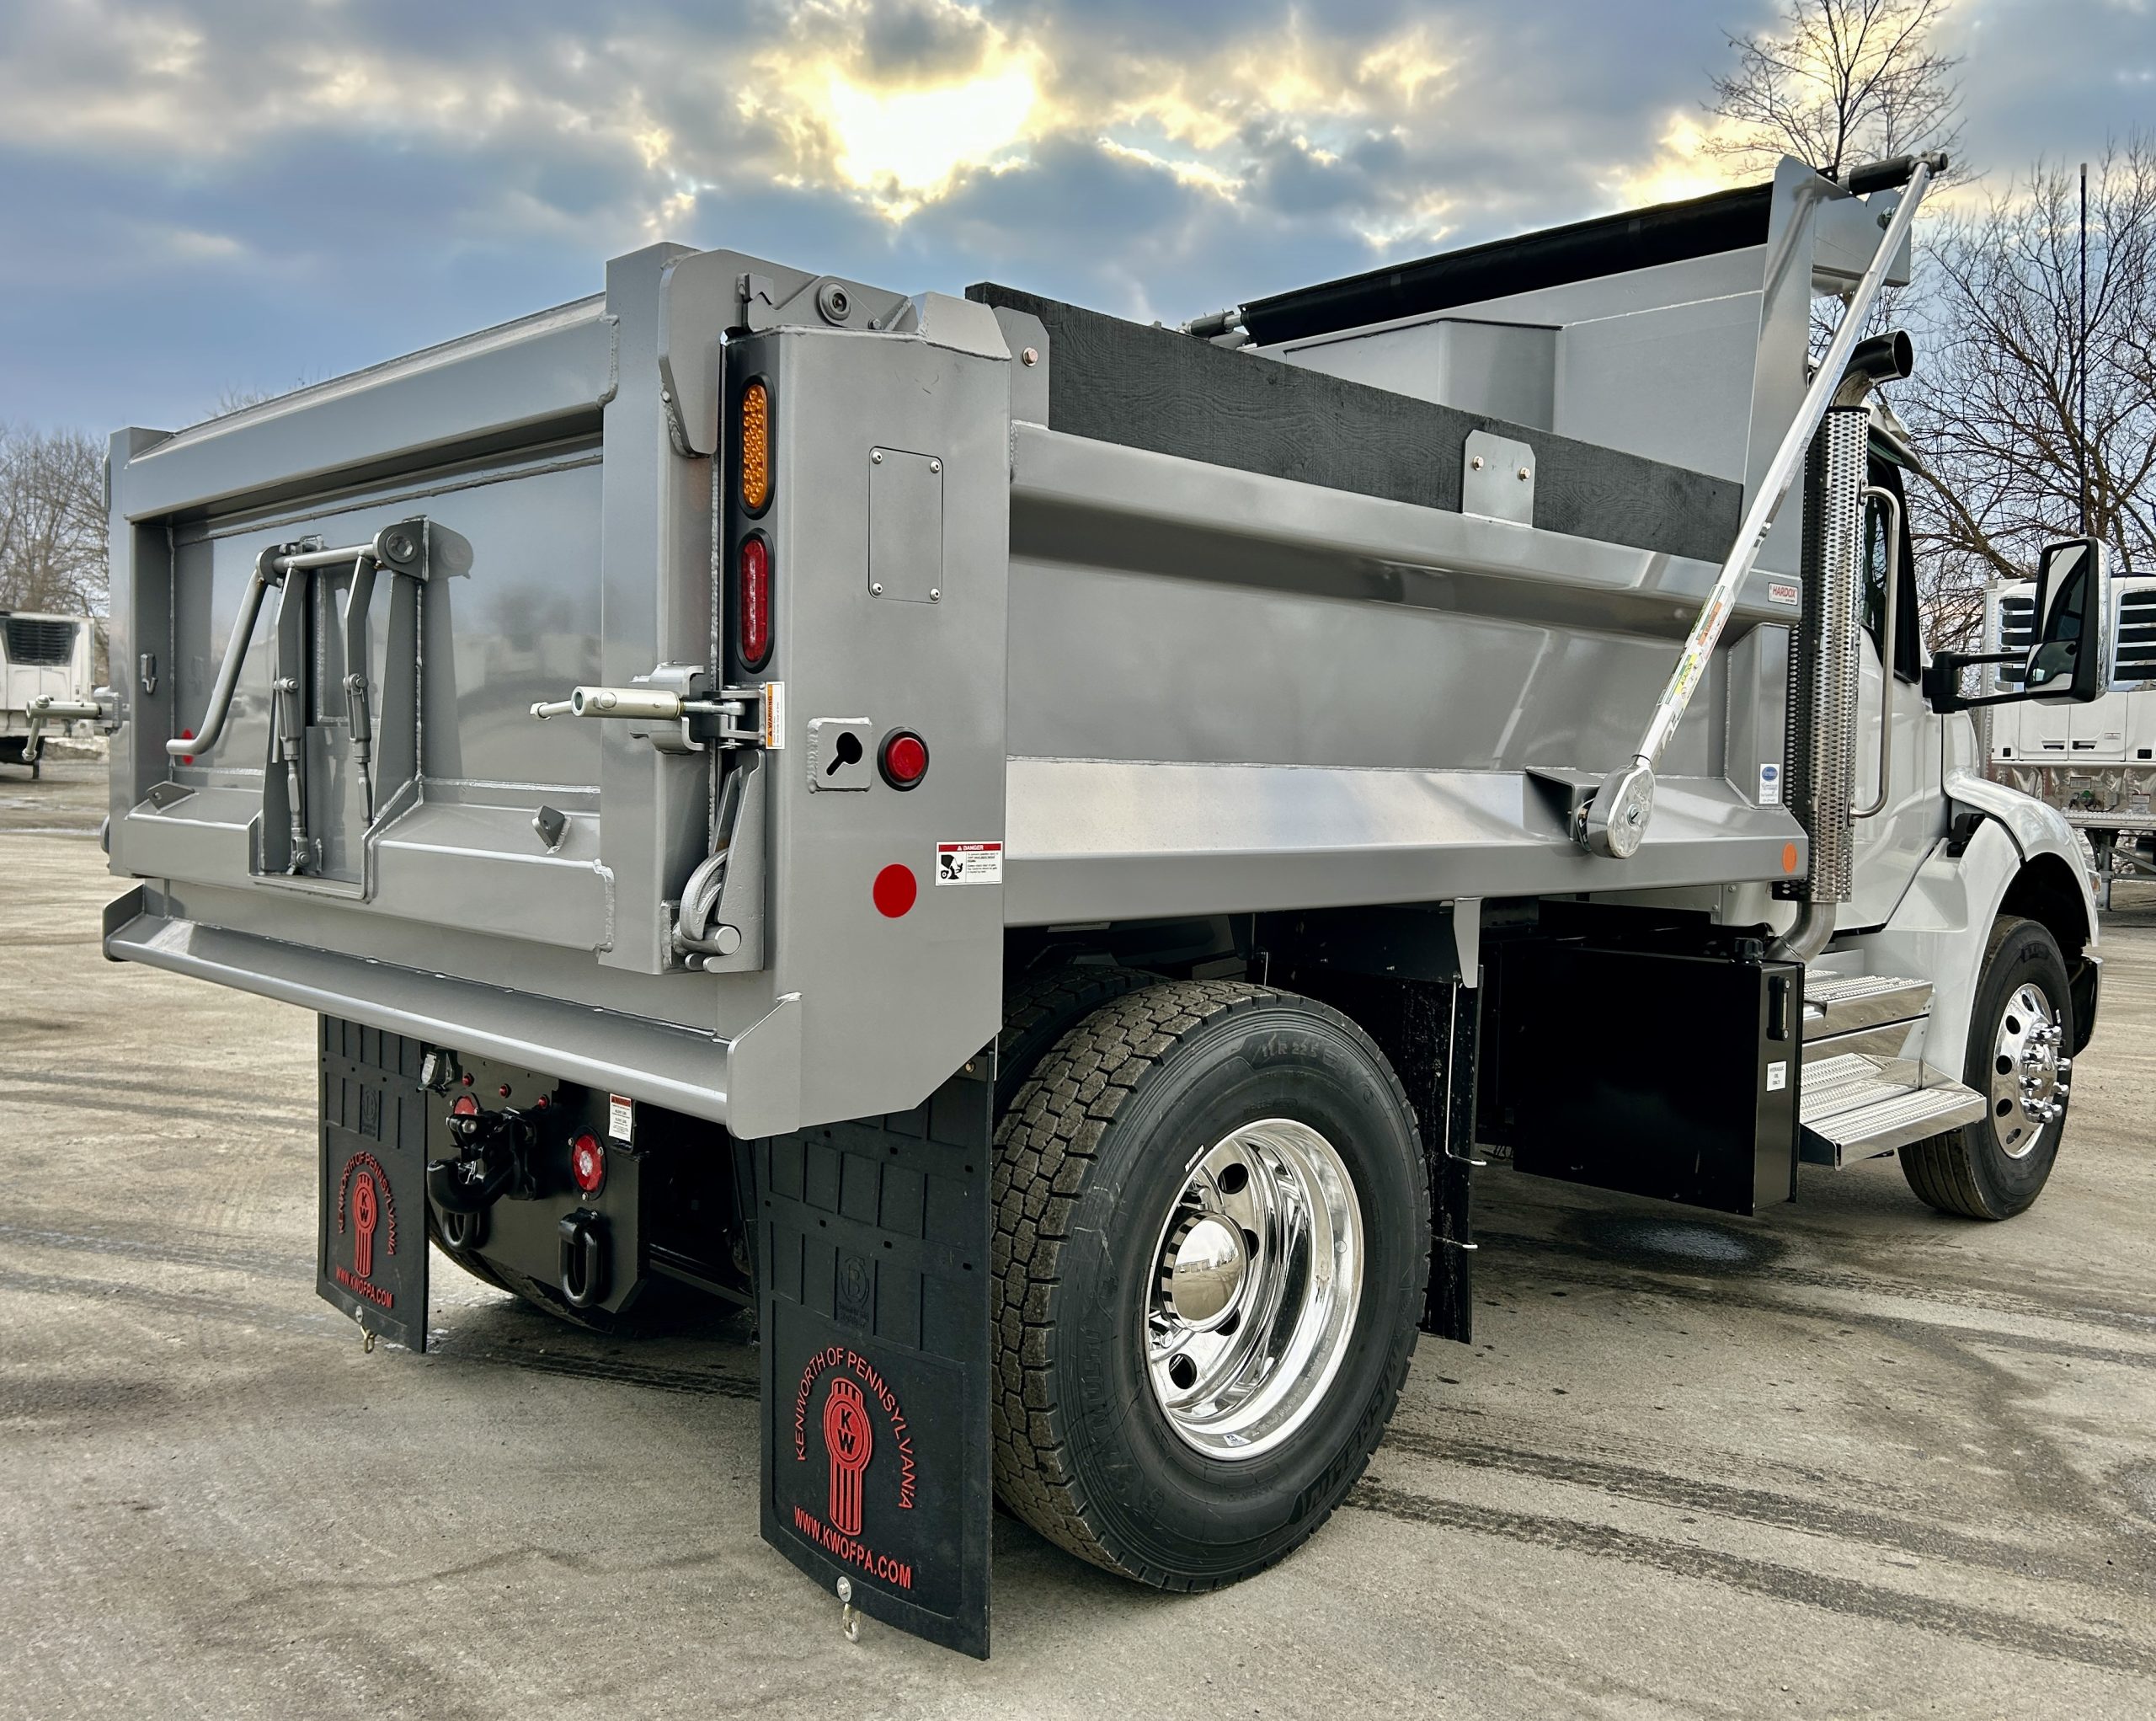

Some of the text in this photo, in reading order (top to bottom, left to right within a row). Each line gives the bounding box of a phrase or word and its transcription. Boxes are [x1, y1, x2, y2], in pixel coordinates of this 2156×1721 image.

[1772, 585, 1796, 598] HARDOX
[795, 1351, 826, 1462] KENWORTH
[826, 1347, 845, 1367] OF
[846, 1350, 918, 1510] PENNSYLVANIA
[794, 1505, 912, 1590] WWW.KWOFPA.COM
